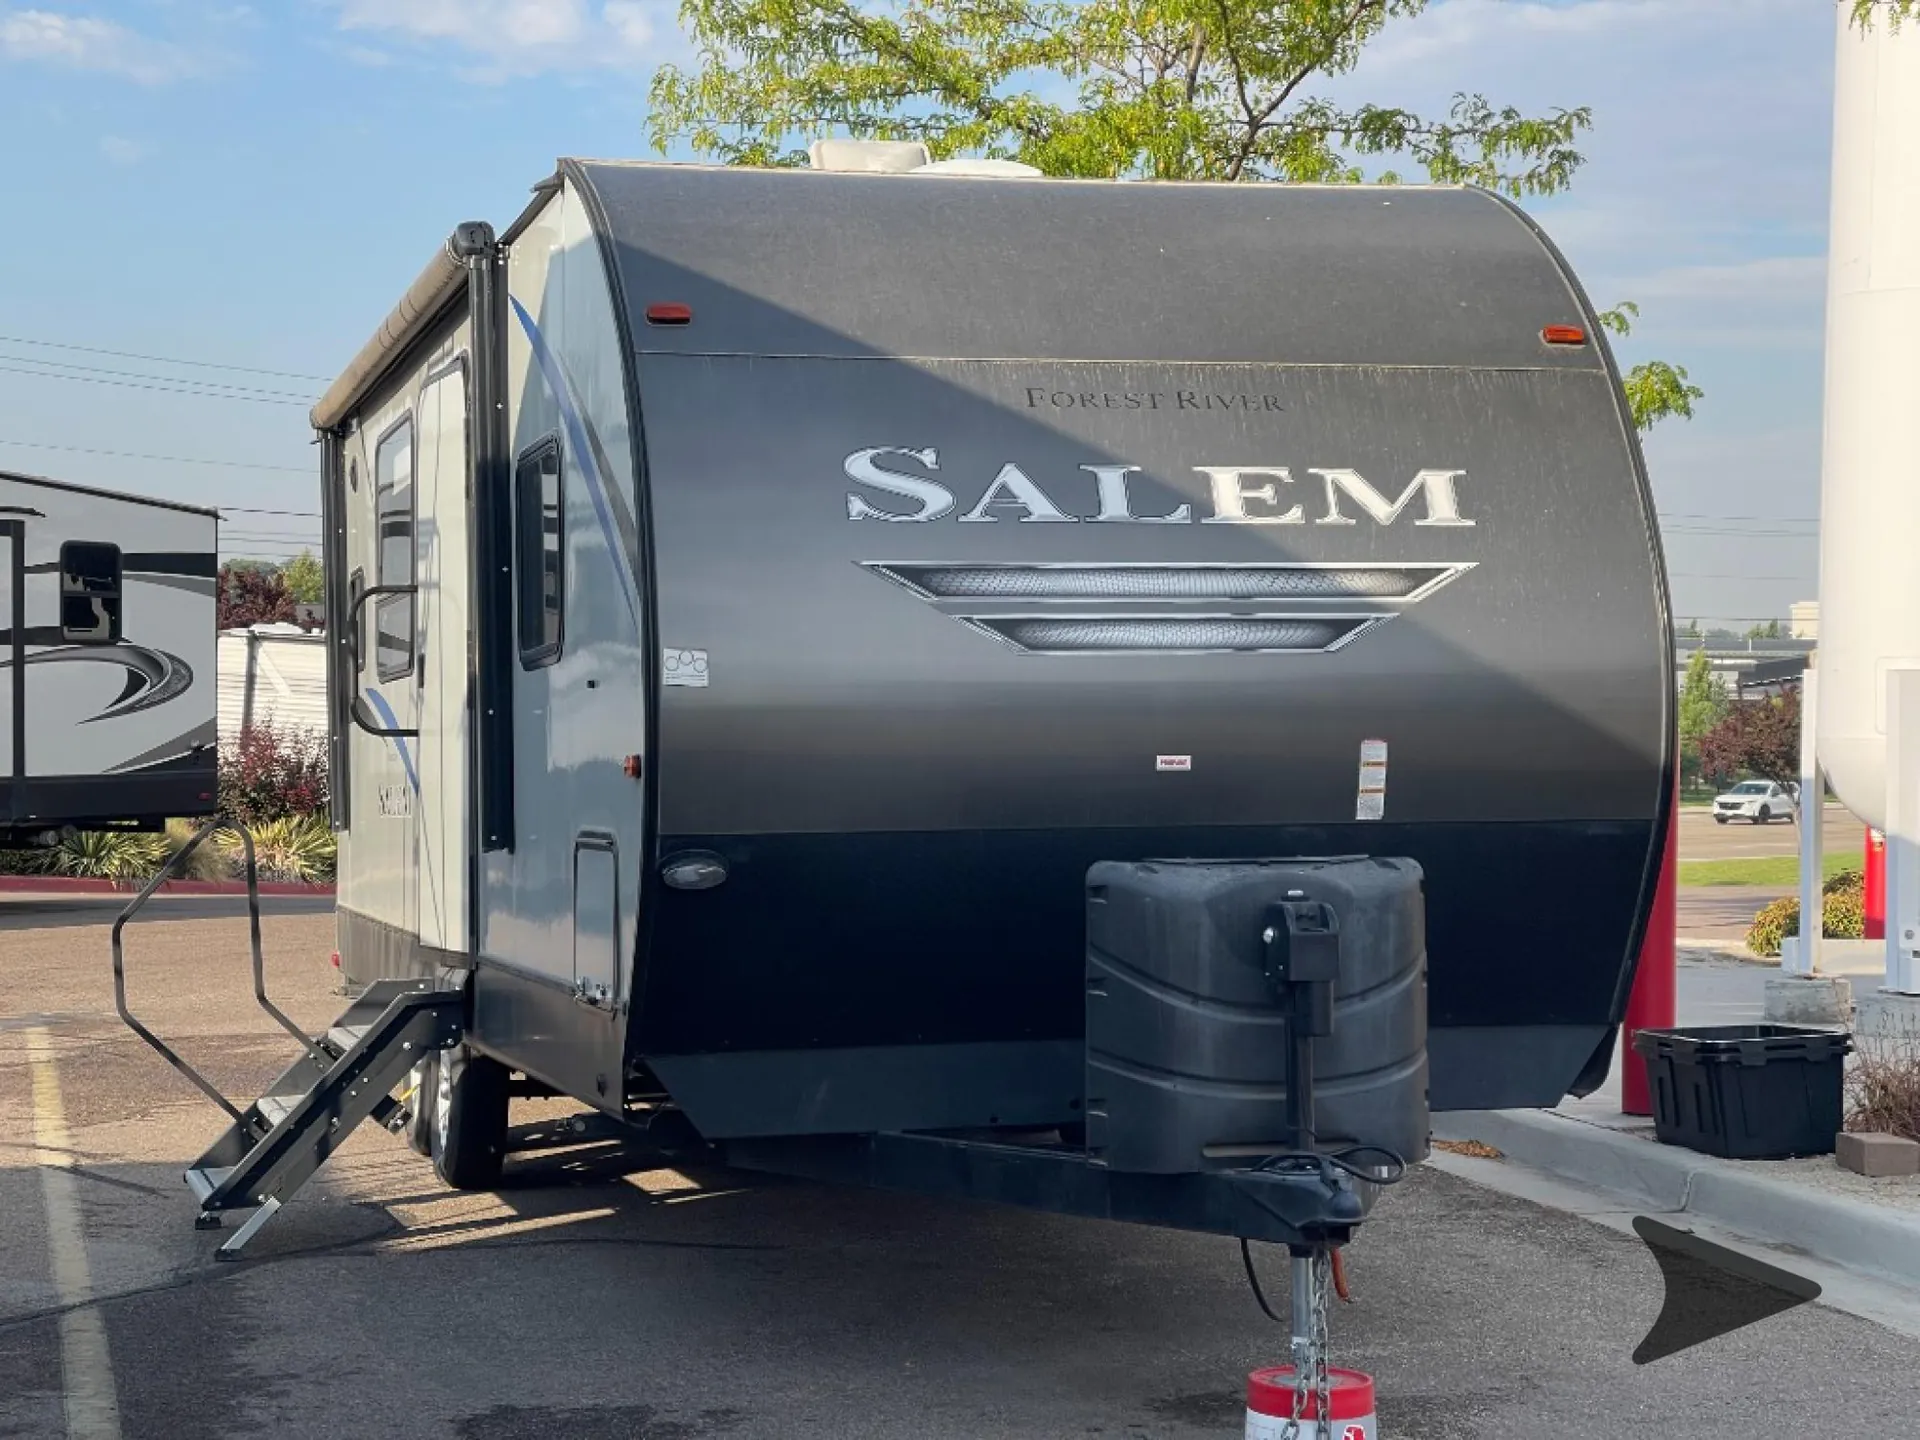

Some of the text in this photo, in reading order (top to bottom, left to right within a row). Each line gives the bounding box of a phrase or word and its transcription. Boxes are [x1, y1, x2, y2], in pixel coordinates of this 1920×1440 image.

[1025, 388, 1285, 411] FOREST RIVER
[843, 446, 1477, 526] SALEM
